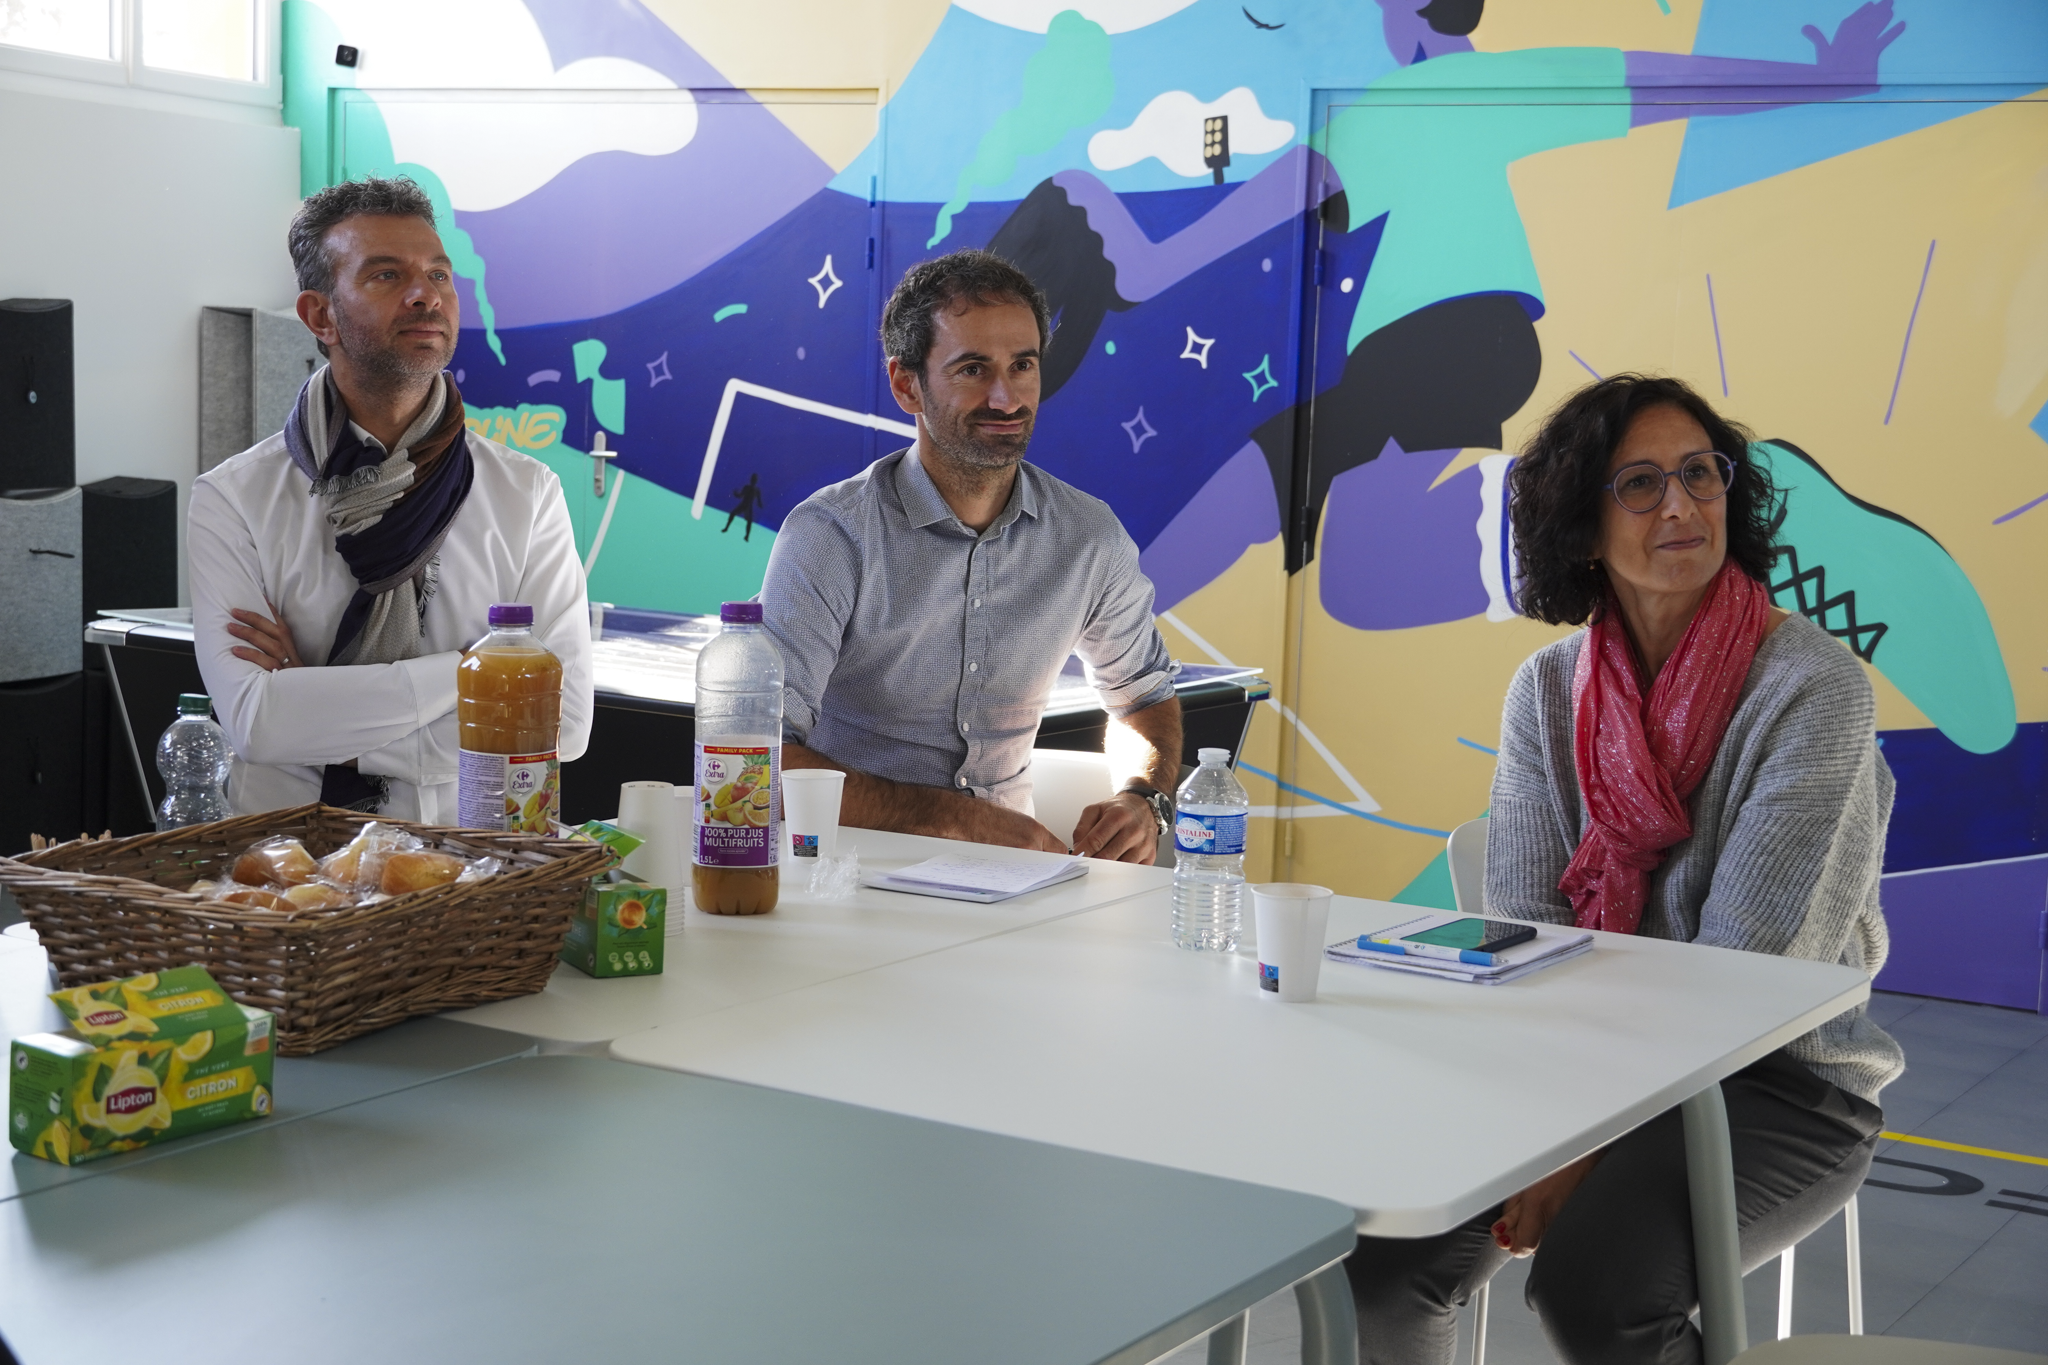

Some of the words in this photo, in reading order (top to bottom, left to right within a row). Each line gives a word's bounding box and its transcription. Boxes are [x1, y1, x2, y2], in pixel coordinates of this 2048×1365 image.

[704, 769, 725, 779] Extra
[512, 781, 533, 790] Extra
[705, 828, 726, 837] 100%
[728, 829, 746, 837] PUR
[747, 829, 763, 837] JUS
[704, 837, 764, 847] MULTIFRUITS
[159, 996, 204, 1011] CITRON
[87, 1011, 124, 1026] Lipton
[187, 1076, 237, 1099] CITRON
[110, 1091, 153, 1112] Lipton
